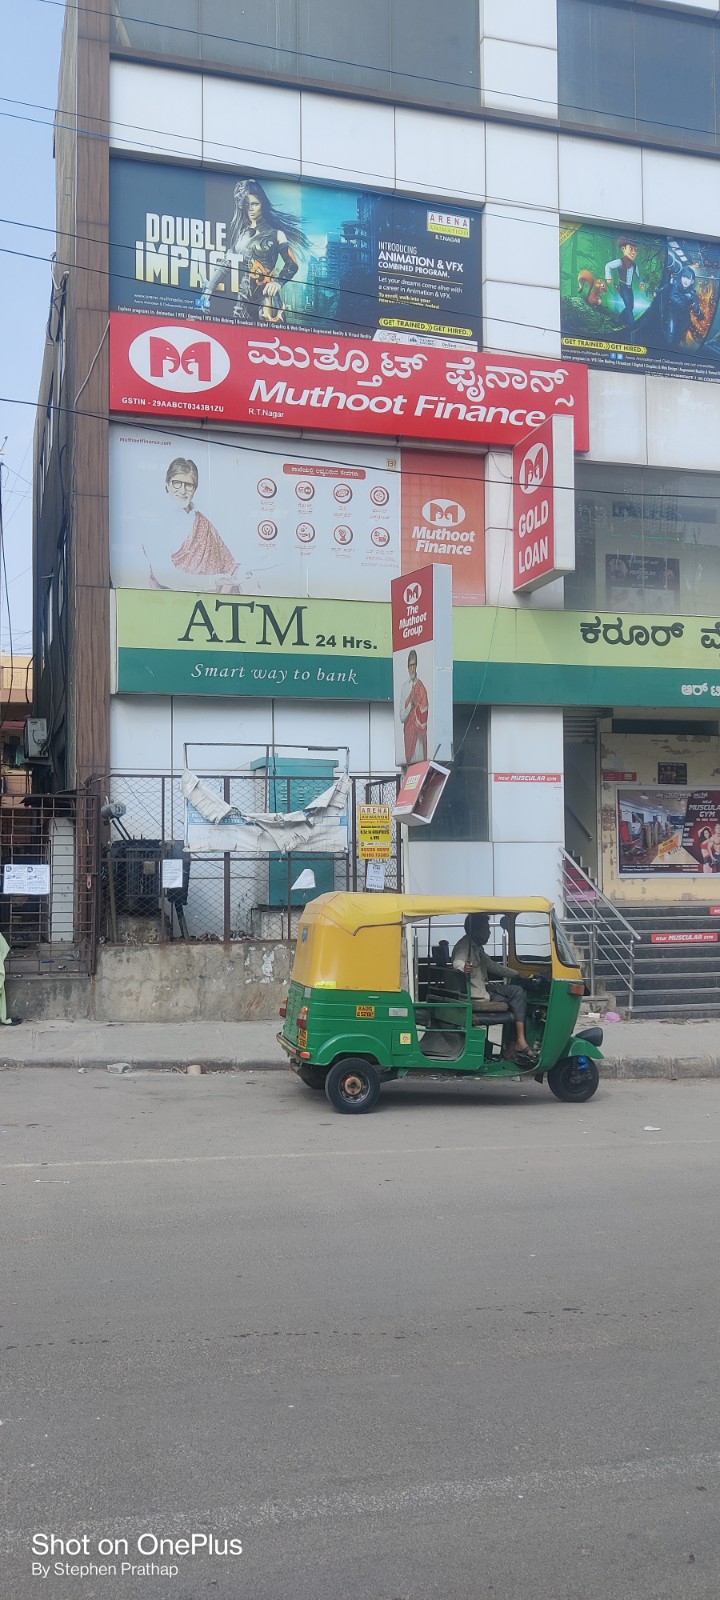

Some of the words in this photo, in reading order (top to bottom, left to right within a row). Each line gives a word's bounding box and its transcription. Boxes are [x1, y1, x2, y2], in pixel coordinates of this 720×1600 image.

[430, 214, 468, 227] ARENA
[145, 213, 227, 252] DOUBLE
[378, 241, 417, 255] INTRODUCING
[135, 240, 243, 293] IMPACT
[378, 251, 434, 268] ANIMATION
[437, 259, 444, 270] &
[445, 261, 464, 272] VFX
[378, 261, 414, 272] COMBINED
[401, 278, 421, 287] dreams
[438, 284, 450, 292] alive
[406, 288, 434, 297] Animation
[247, 337, 428, 387] ಮುತ್ತೂಟ್
[445, 356, 574, 407] ಫೈನಾನ್ಸ್
[121, 397, 146, 405] GSTIN
[249, 379, 408, 416] Muthoot
[414, 394, 546, 427] Finance
[248, 407, 285, 418] R.T.Nagar
[119, 436, 172, 447] muthootfinance.com
[518, 500, 549, 538] GOLD
[412, 526, 476, 542] Muthoot
[415, 540, 472, 555] Finance
[518, 536, 549, 574] LOAN
[406, 605, 419, 616] The
[177, 599, 309, 646] ATM
[315, 635, 336, 648] 24
[342, 635, 378, 649] Hrs.
[398, 612, 427, 630] Muthoot
[402, 625, 423, 639] Group
[580, 615, 685, 647] ಕರೂರ್
[190, 663, 246, 679] Smart
[250, 667, 288, 683] way
[293, 668, 310, 681] to
[316, 668, 359, 684] bank
